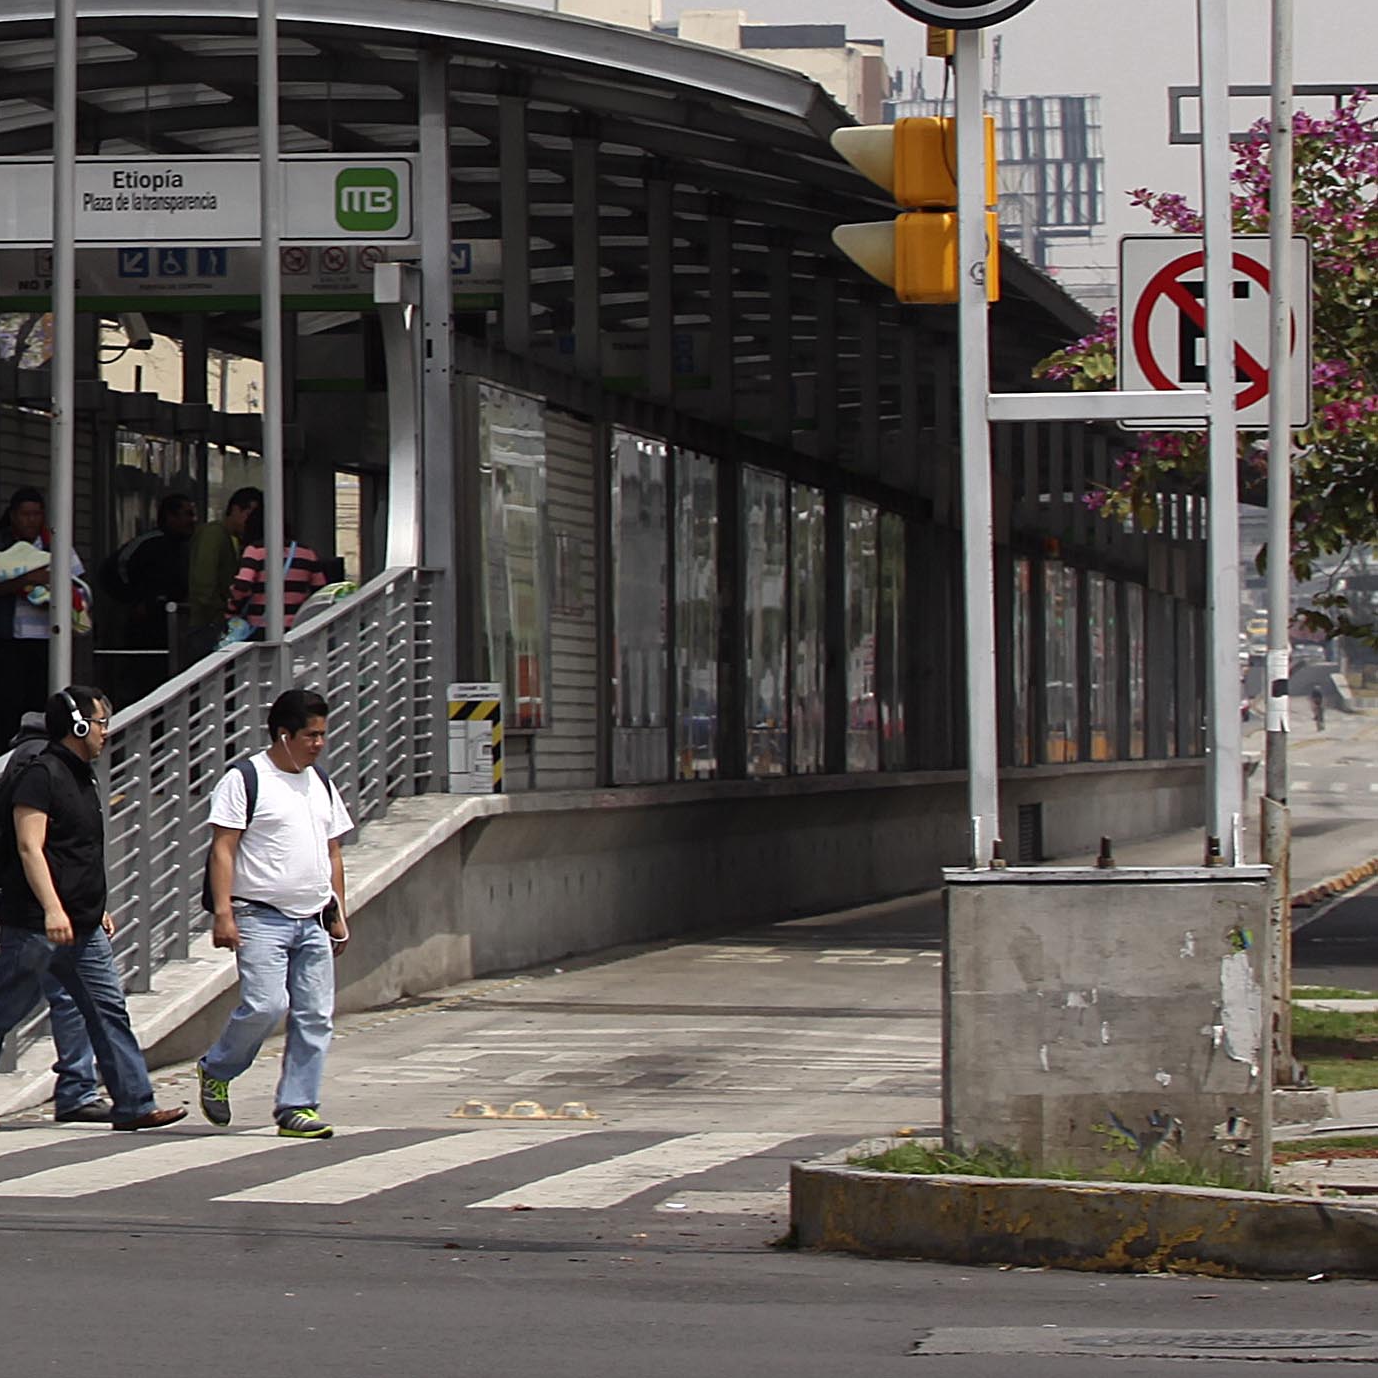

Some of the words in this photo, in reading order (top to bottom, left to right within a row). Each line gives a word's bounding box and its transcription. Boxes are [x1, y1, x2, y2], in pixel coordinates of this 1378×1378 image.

[112, 169, 184, 192] Etiopía
[83, 192, 113, 212] Plaza
[115, 192, 130, 211] de
[340, 185, 393, 213] MB
